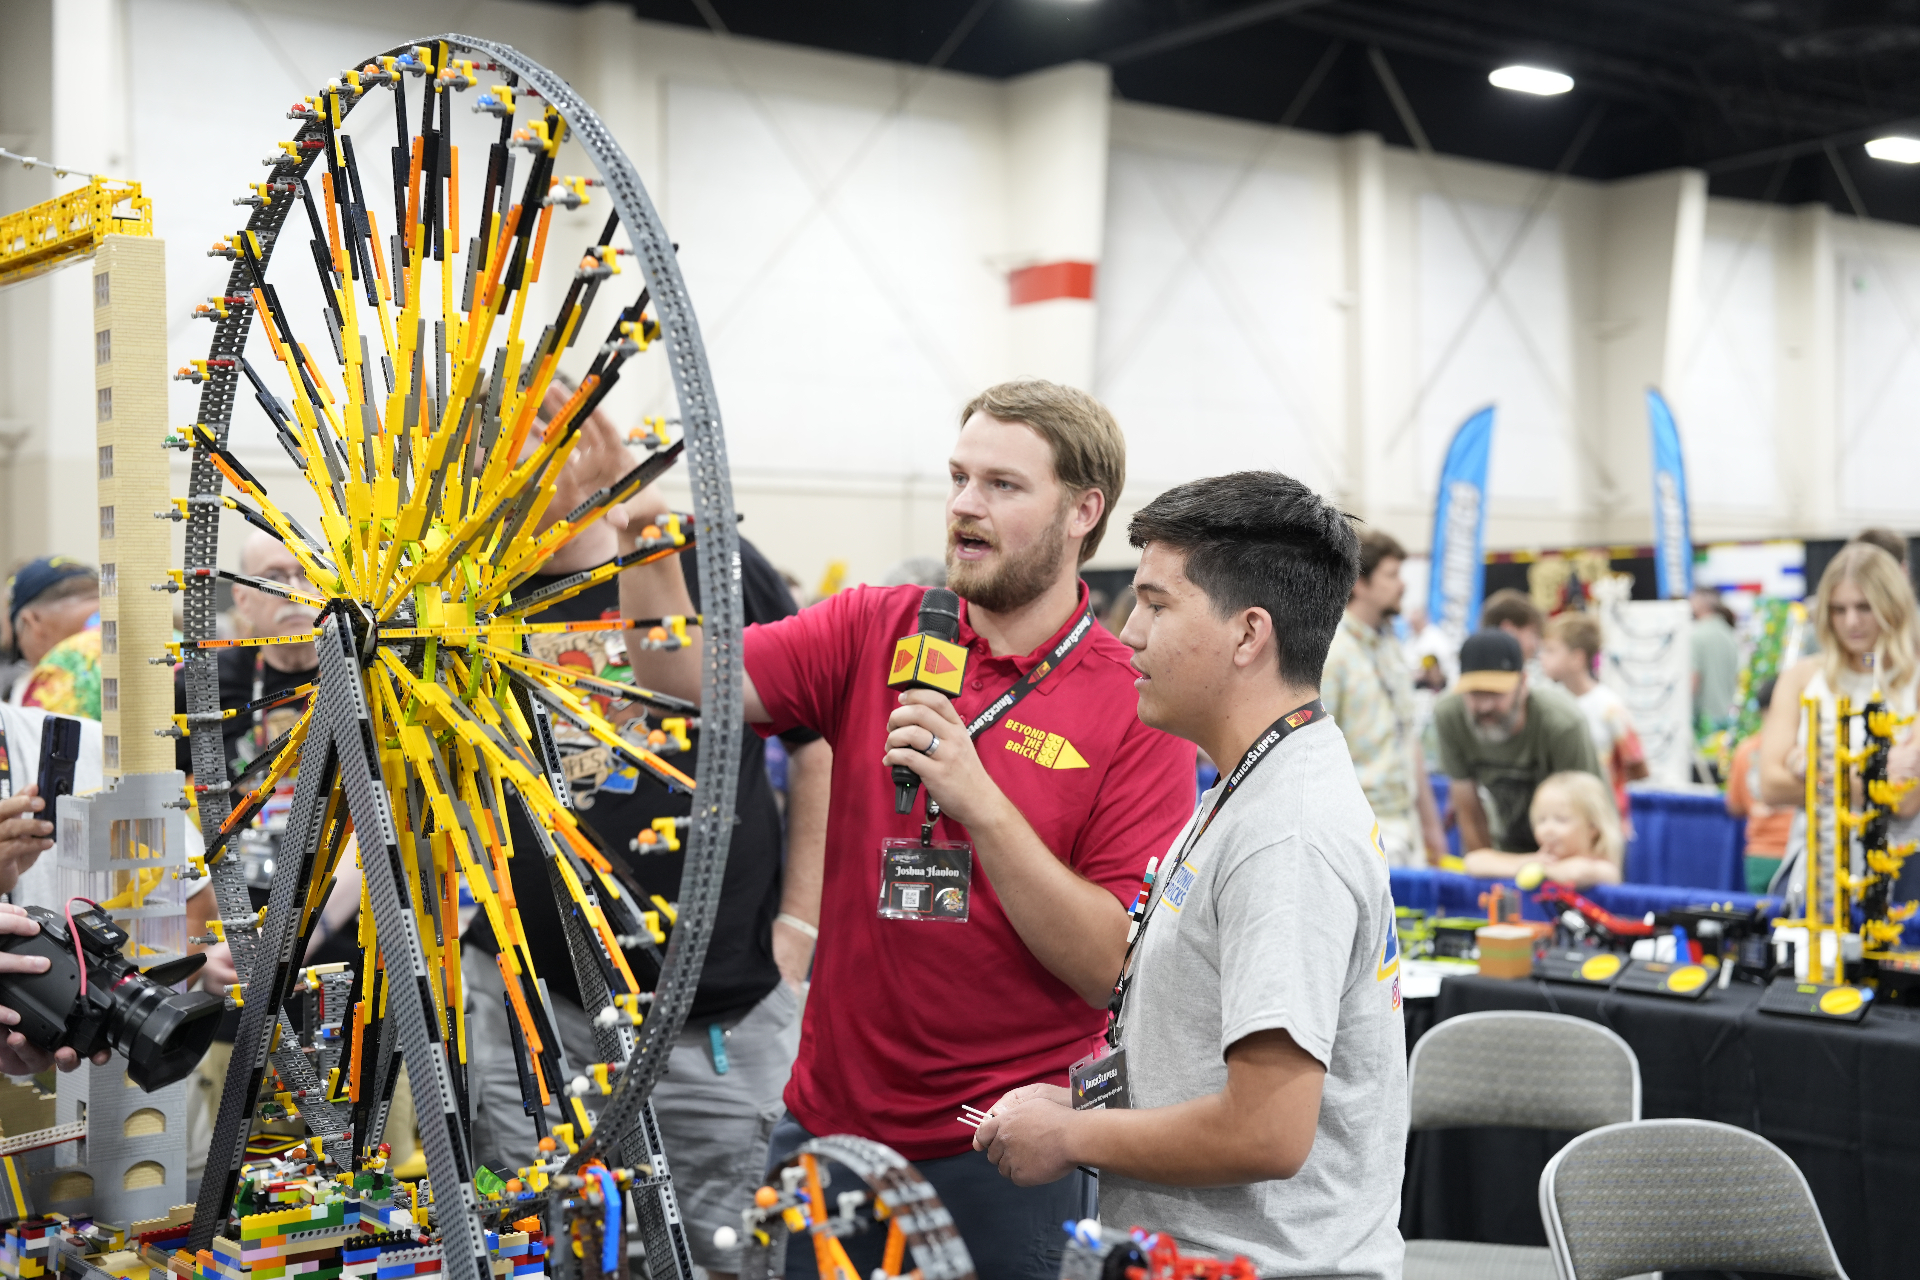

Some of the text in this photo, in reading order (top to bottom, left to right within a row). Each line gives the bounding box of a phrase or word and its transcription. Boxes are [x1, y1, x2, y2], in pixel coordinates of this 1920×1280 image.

[1004, 718, 1047, 741] BEYOND
[1004, 739, 1038, 761] BRICK
[1023, 735, 1043, 751] THE
[563, 751, 602, 776] PES
[1230, 730, 1280, 786] BRICKSLOPES
[895, 865, 960, 878] Joshua Hanlon
[1173, 866, 1196, 891] TONIC
